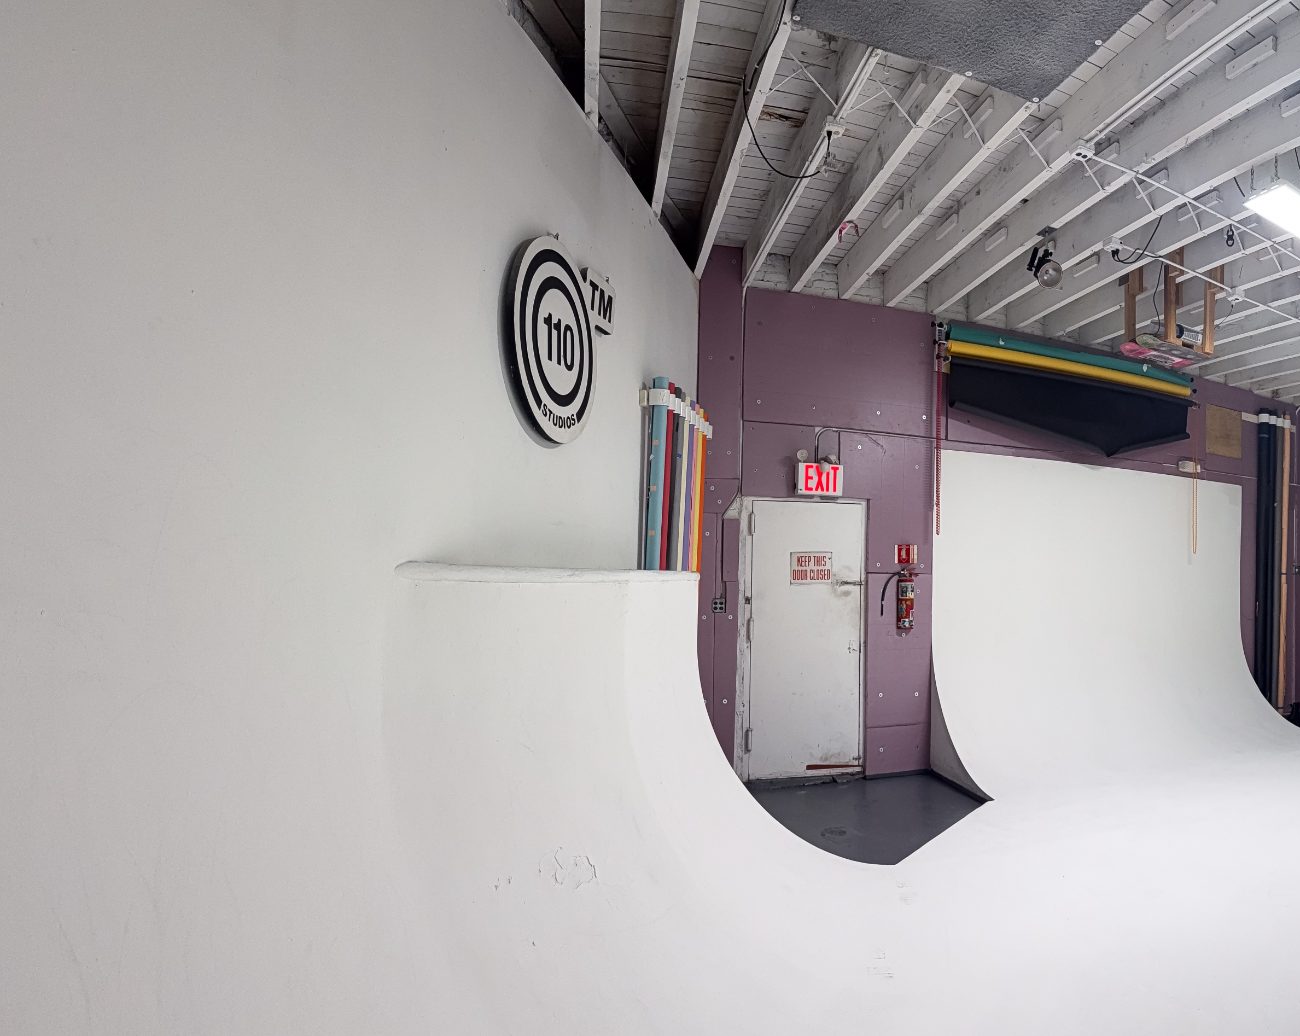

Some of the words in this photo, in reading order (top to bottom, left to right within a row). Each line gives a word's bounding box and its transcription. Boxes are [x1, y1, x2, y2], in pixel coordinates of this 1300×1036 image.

[589, 279, 613, 324] TM
[543, 312, 574, 372] 110
[542, 403, 576, 429] STUDIOS
[804, 464, 840, 493] EXIT
[792, 569, 808, 581] DOOR
[809, 568, 831, 581] CLOSED
[796, 555, 811, 567] KEEP
[813, 555, 826, 567] THIS
